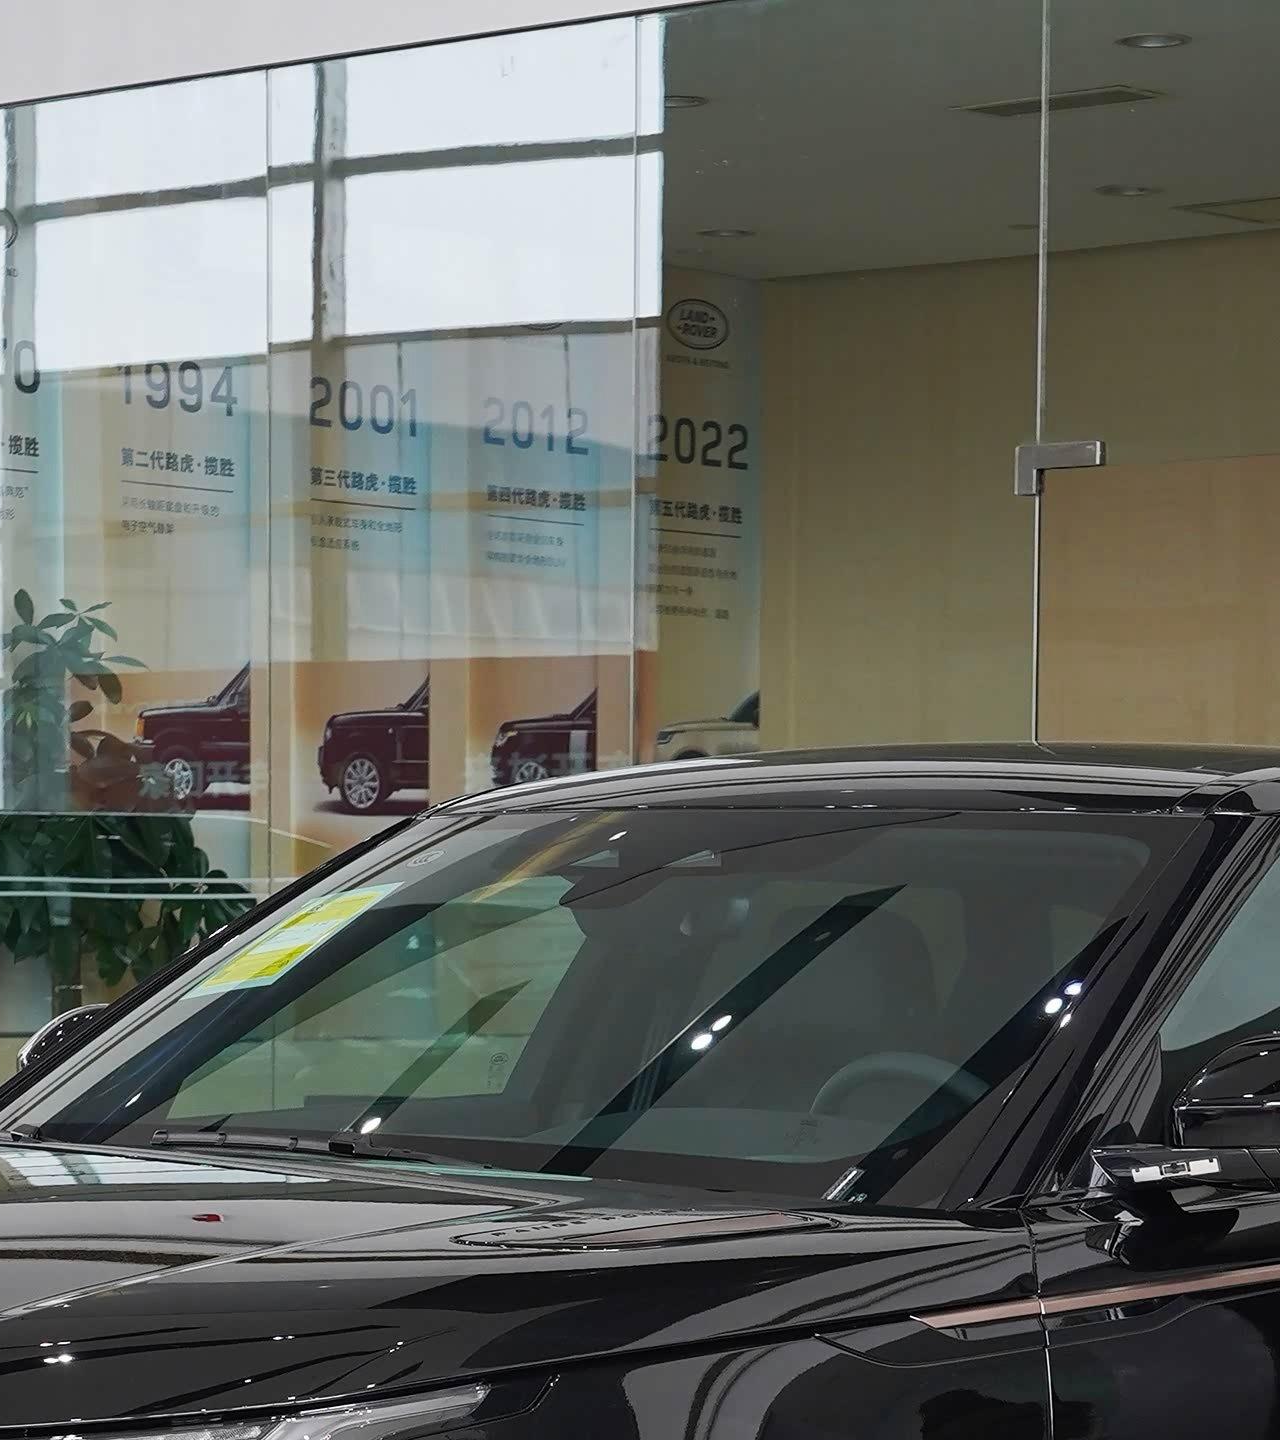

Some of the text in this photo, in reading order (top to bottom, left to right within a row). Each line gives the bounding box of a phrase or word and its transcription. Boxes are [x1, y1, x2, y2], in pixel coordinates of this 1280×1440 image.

[119, 360, 238, 416] 1994
[310, 376, 417, 437] 2001
[484, 397, 589, 456] 2012
[647, 414, 749, 471] 2022
